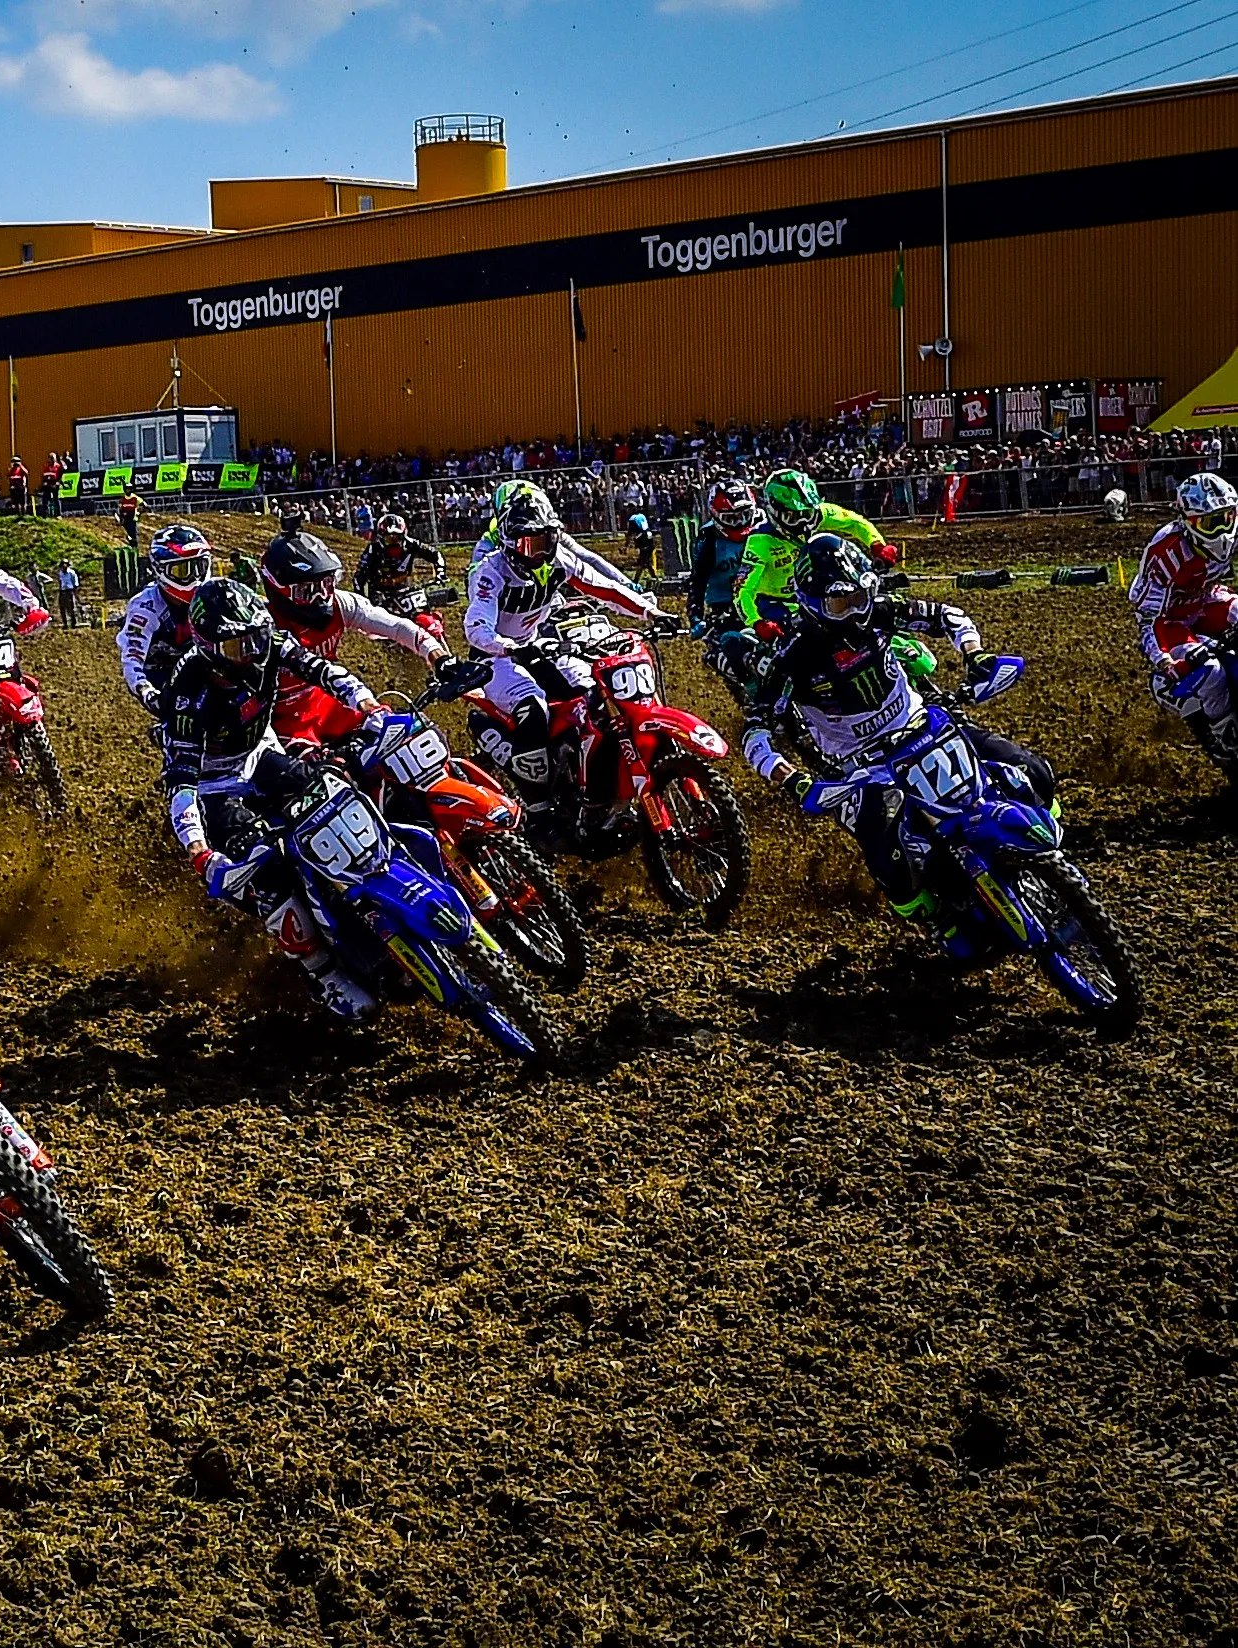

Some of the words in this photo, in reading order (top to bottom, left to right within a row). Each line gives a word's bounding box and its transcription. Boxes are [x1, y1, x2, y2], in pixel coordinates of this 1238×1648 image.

[640, 216, 848, 273] Toggenburger
[187, 284, 343, 331] Toggenburger
[1005, 390, 1042, 411] HOTDOGS
[1005, 410, 1042, 433] POMMES
[611, 663, 656, 700] 98
[854, 697, 905, 739] YAMAHA
[384, 729, 448, 785] 118
[480, 728, 513, 767] 98
[906, 735, 974, 803] 127
[309, 799, 378, 876] 919
